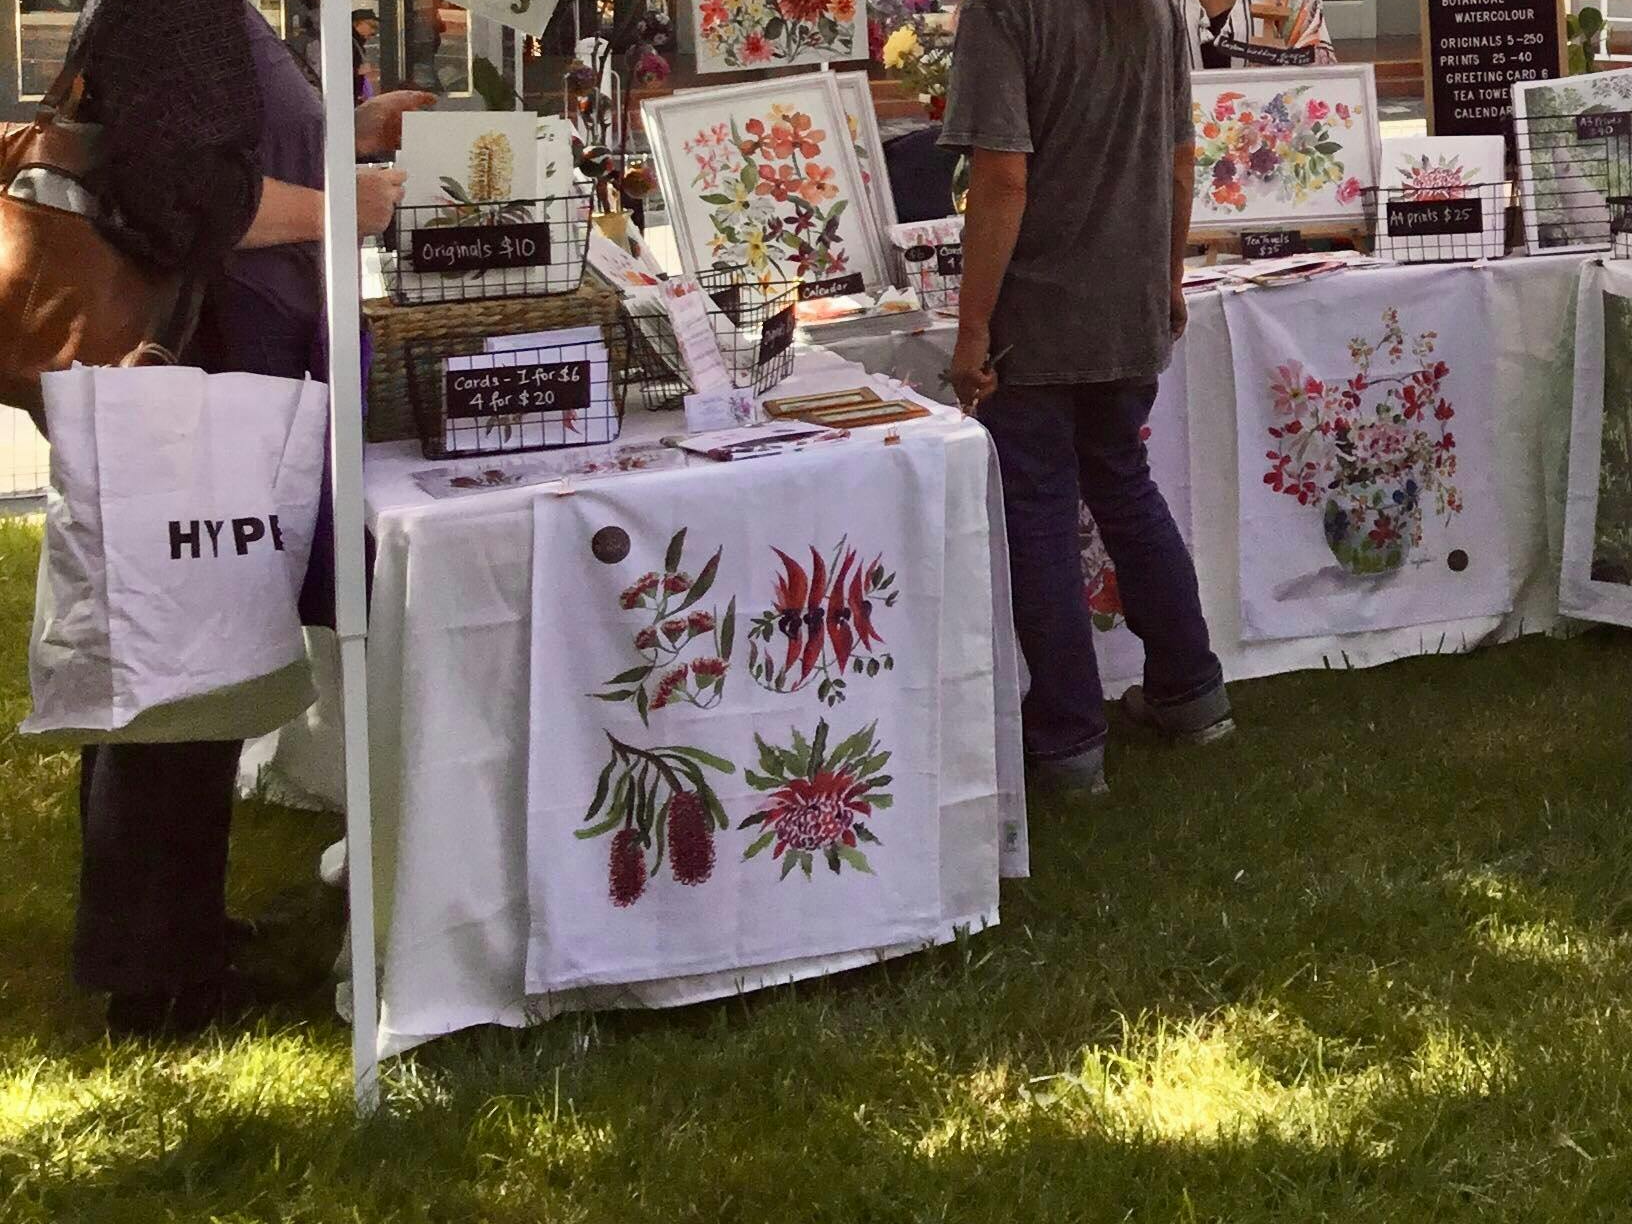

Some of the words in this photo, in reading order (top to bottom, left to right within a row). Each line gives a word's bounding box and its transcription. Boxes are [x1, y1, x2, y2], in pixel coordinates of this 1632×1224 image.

[1454, 9, 1535, 24] WATERCOLOUR
[1440, 35, 1502, 49] ORIGINALS
[1440, 54, 1480, 67] PRINTS
[1492, 53, 1506, 64] 25
[1446, 70, 1503, 84] GREETING
[1506, 68, 1537, 81] CARD
[1453, 89, 1475, 101] TEA
[1407, 208, 1438, 228] prints
[422, 238, 492, 266] Originals
[500, 236, 536, 258] $10
[801, 282, 848, 300] Calendar
[531, 368, 555, 386] for
[557, 365, 581, 383] $6
[469, 393, 484, 411] 4
[489, 392, 514, 412] for
